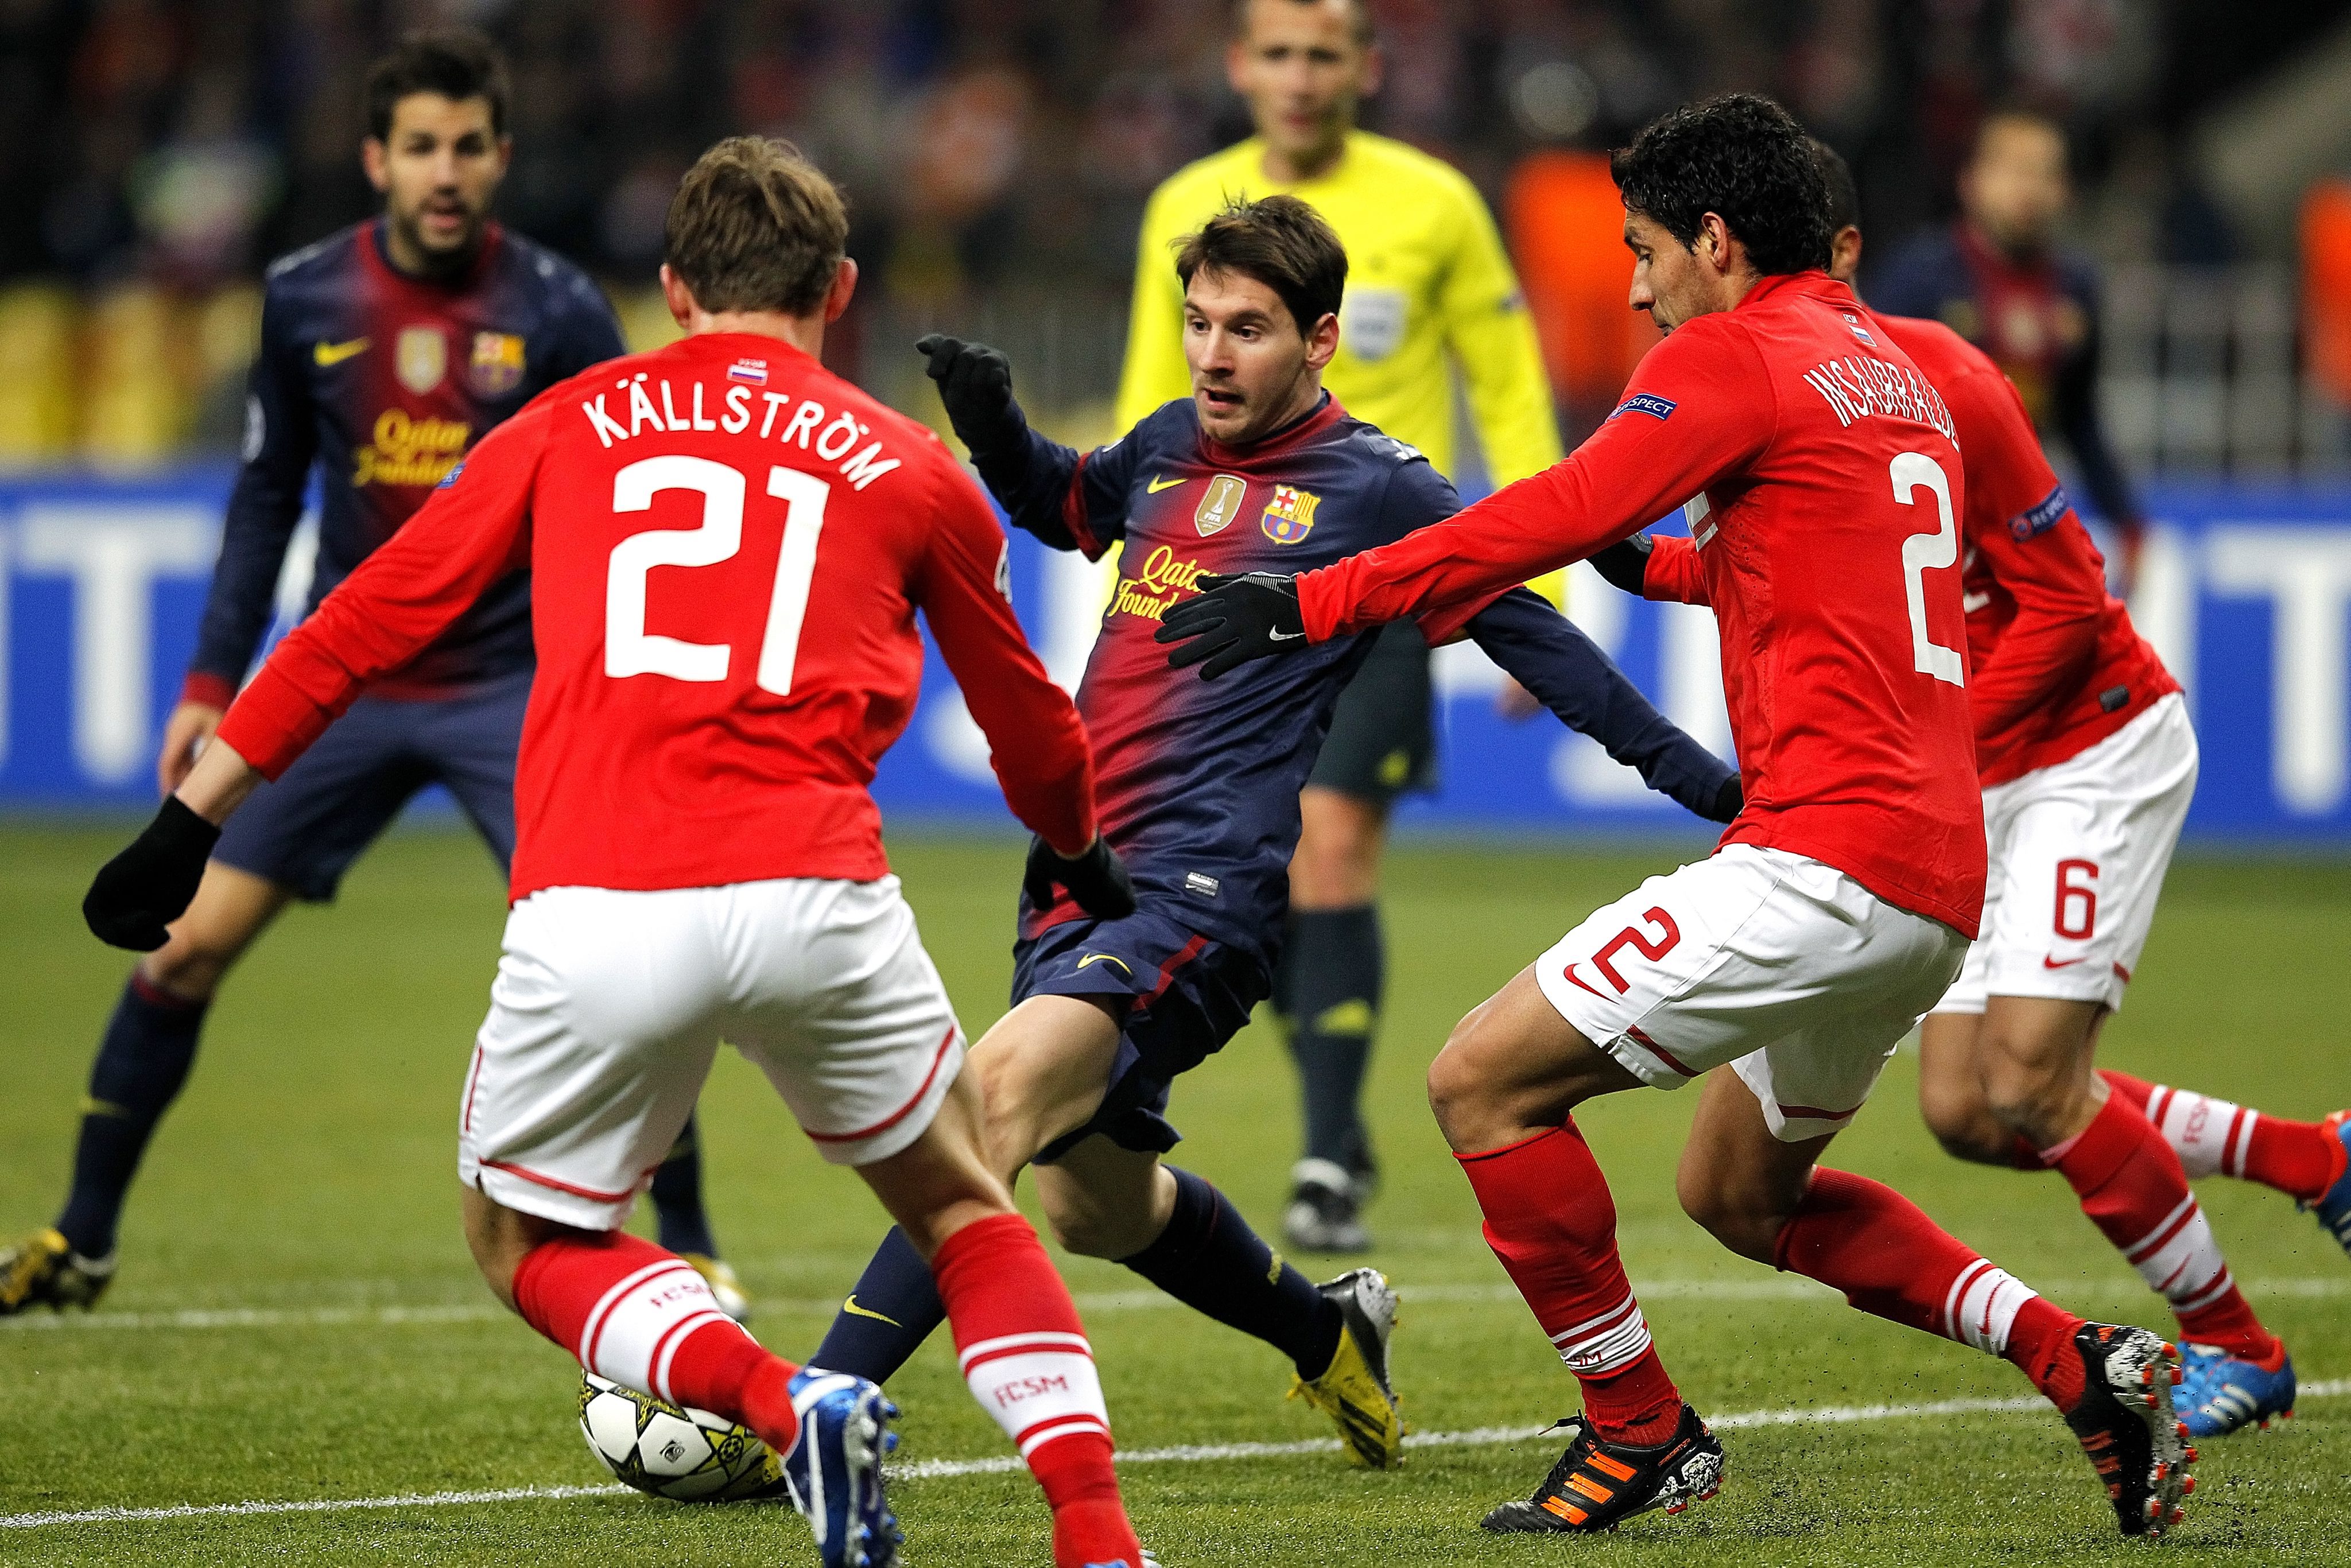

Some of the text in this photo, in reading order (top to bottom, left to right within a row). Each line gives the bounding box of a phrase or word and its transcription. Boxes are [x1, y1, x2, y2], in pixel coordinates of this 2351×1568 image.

[583, 372, 901, 491] KÄLLSTRÖM
[605, 455, 831, 696] 21
[1139, 545, 1219, 595] Qata
[1890, 452, 1965, 689] 2
[2054, 859, 2098, 940] 6
[1591, 906, 1681, 995] 2
[993, 1375, 1068, 1409] FCSM
